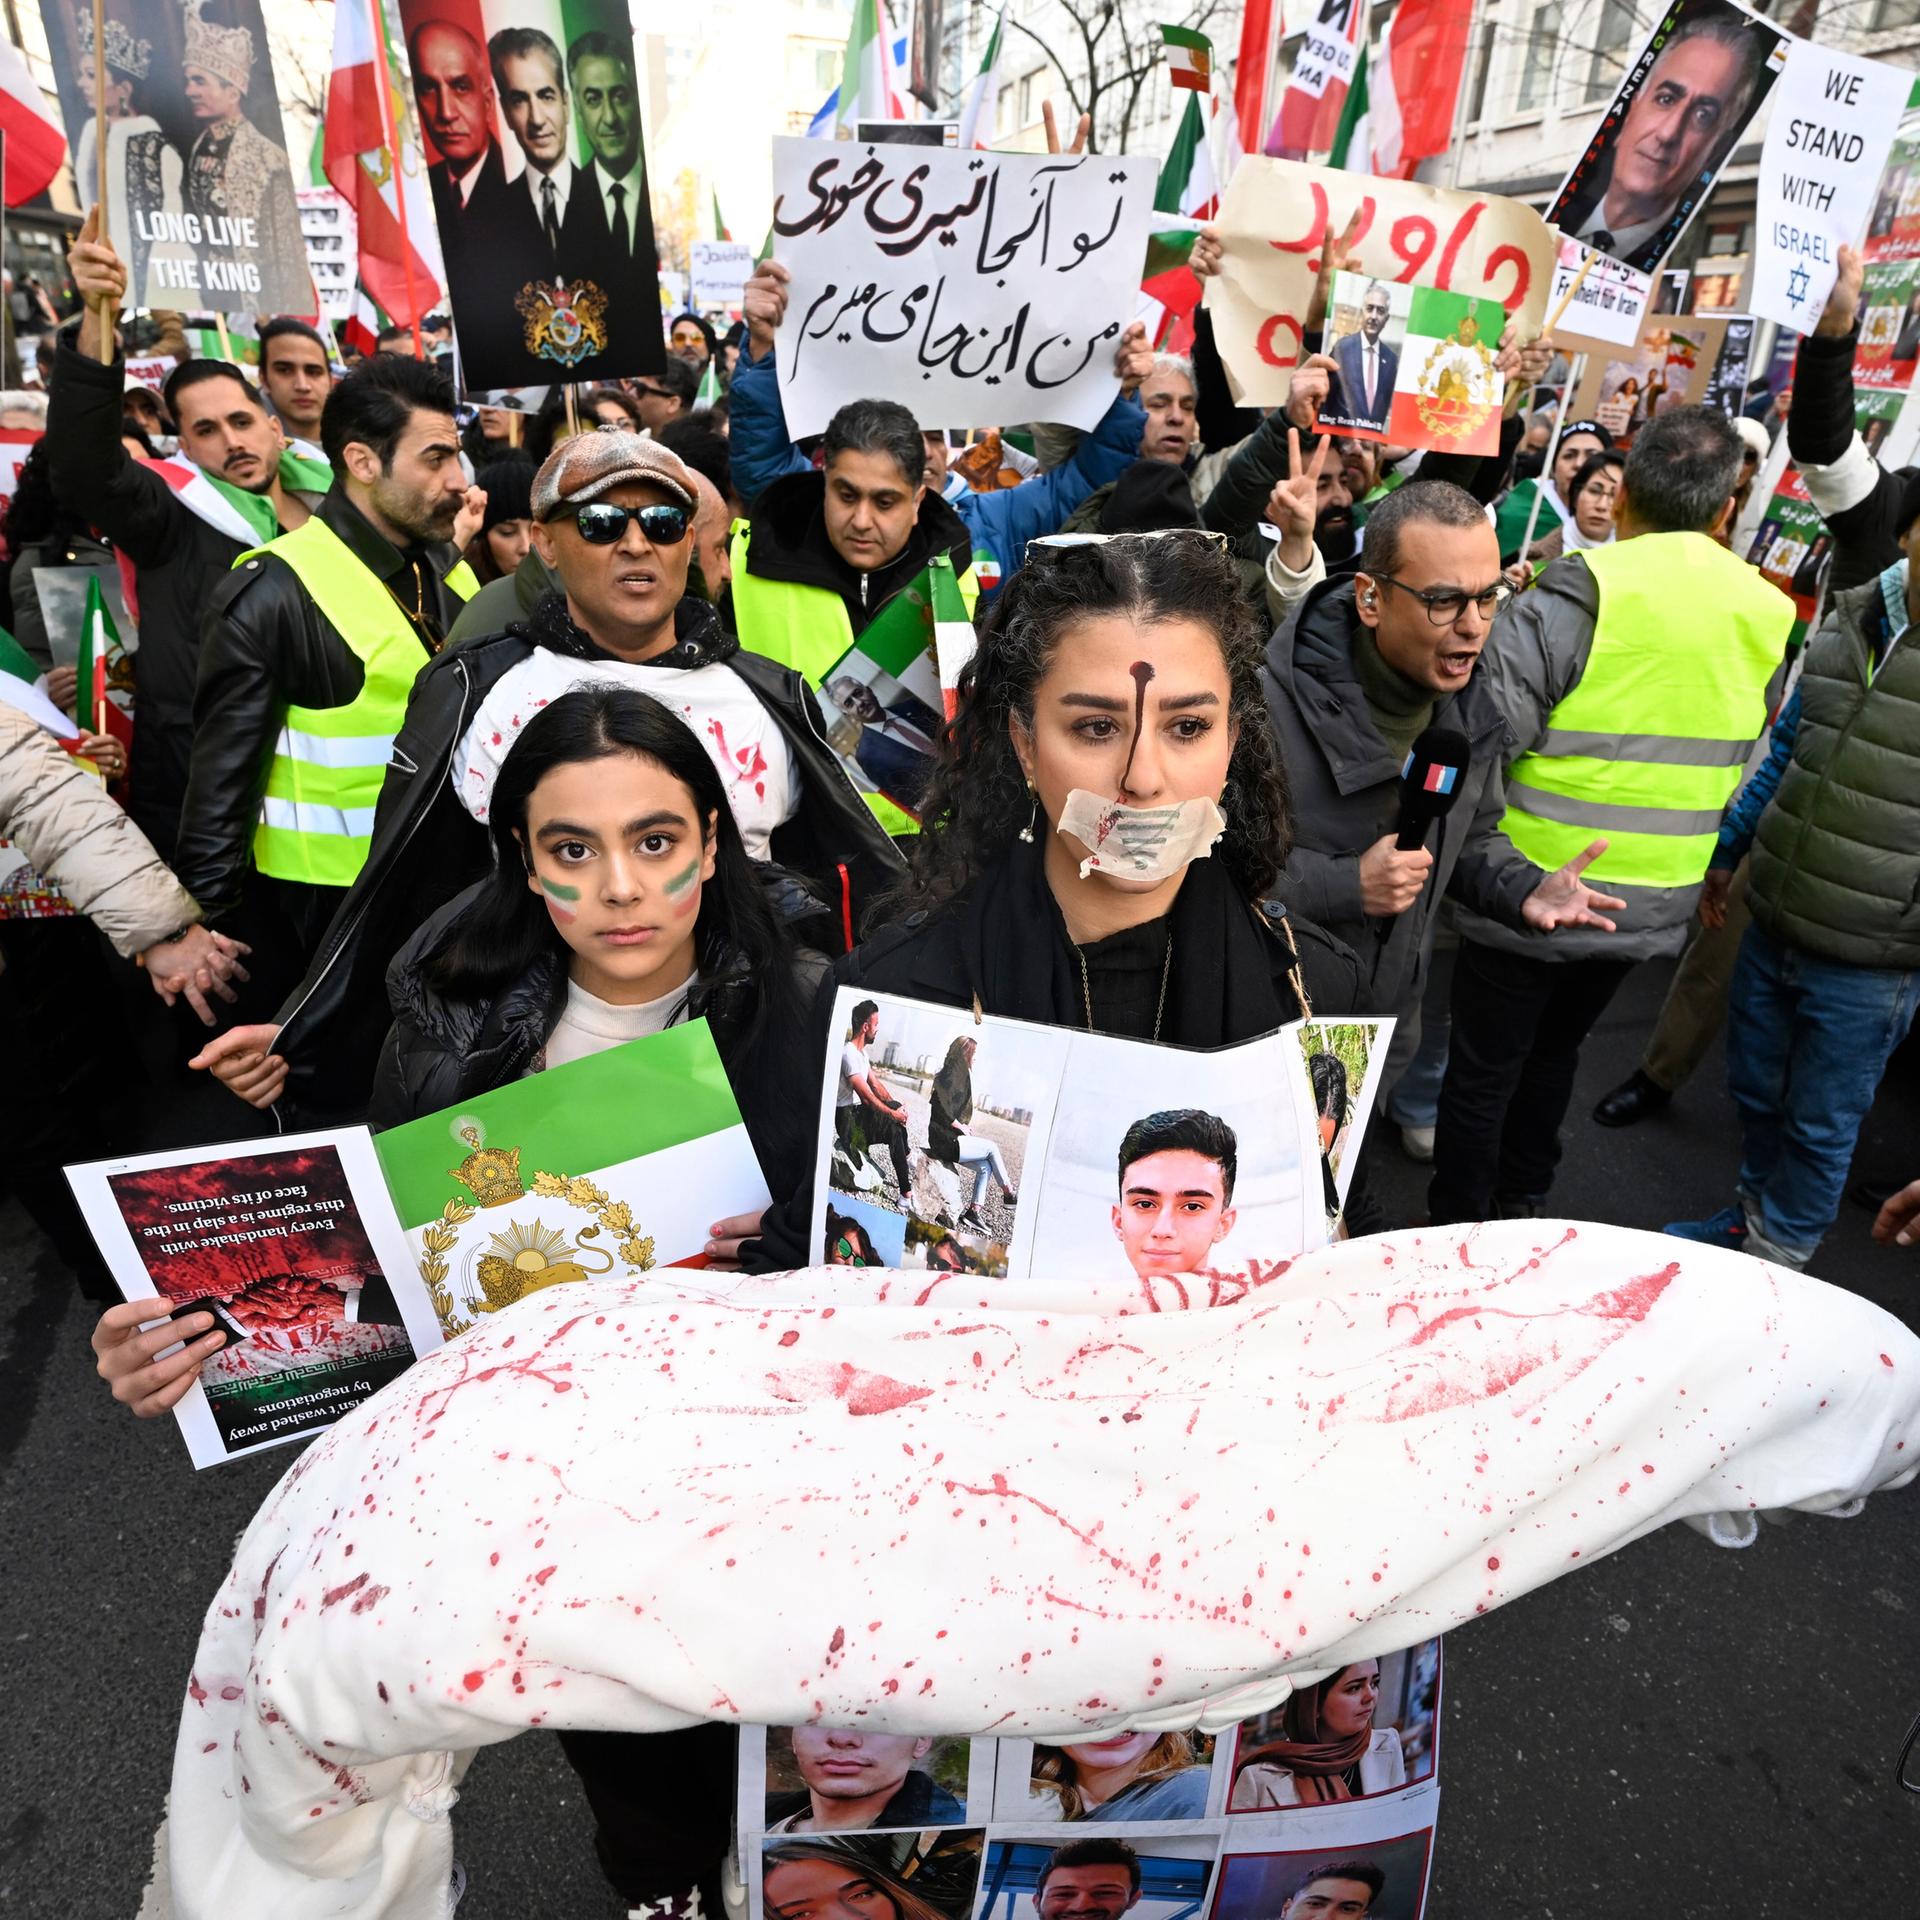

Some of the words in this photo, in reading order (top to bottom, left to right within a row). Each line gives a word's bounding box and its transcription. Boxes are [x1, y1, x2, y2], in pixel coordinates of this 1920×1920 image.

[1612, 51, 1655, 116] REZA
[1824, 68, 1864, 106] WE
[1786, 119, 1864, 164] STAND
[1551, 117, 1616, 223] PAHLAVI
[773, 146, 884, 238] خوری
[1782, 173, 1836, 213] WITH
[135, 210, 202, 244] LONG
[204, 215, 259, 248] LIVE
[977, 156, 1088, 288] آنجا
[1056, 170, 1128, 272] تو
[1643, 200, 1692, 270] EXILE
[1774, 221, 1831, 264] ISRAEL
[150, 258, 201, 289] THE
[203, 260, 262, 293] KING
[1616, 292, 1638, 316] Iran
[1025, 321, 1120, 389] من
[233, 1192, 254, 1205] its
[255, 1190, 273, 1204] of
[275, 1185, 308, 1198] face
[163, 1197, 230, 1214] victims.
[241, 1211, 256, 1223] is
[256, 1203, 312, 1220] regime
[315, 1199, 346, 1213] this
[143, 1224, 172, 1238] the
[175, 1221, 191, 1232] in
[193, 1215, 229, 1230] slap
[232, 1216, 240, 1224] a
[290, 1218, 336, 1234] Every
[159, 1239, 198, 1255] with
[200, 1226, 289, 1248] handshake
[353, 1380, 371, 1392] by
[253, 1386, 350, 1415] negotiations.
[271, 1407, 328, 1431] washed
[229, 1425, 268, 1441] away
